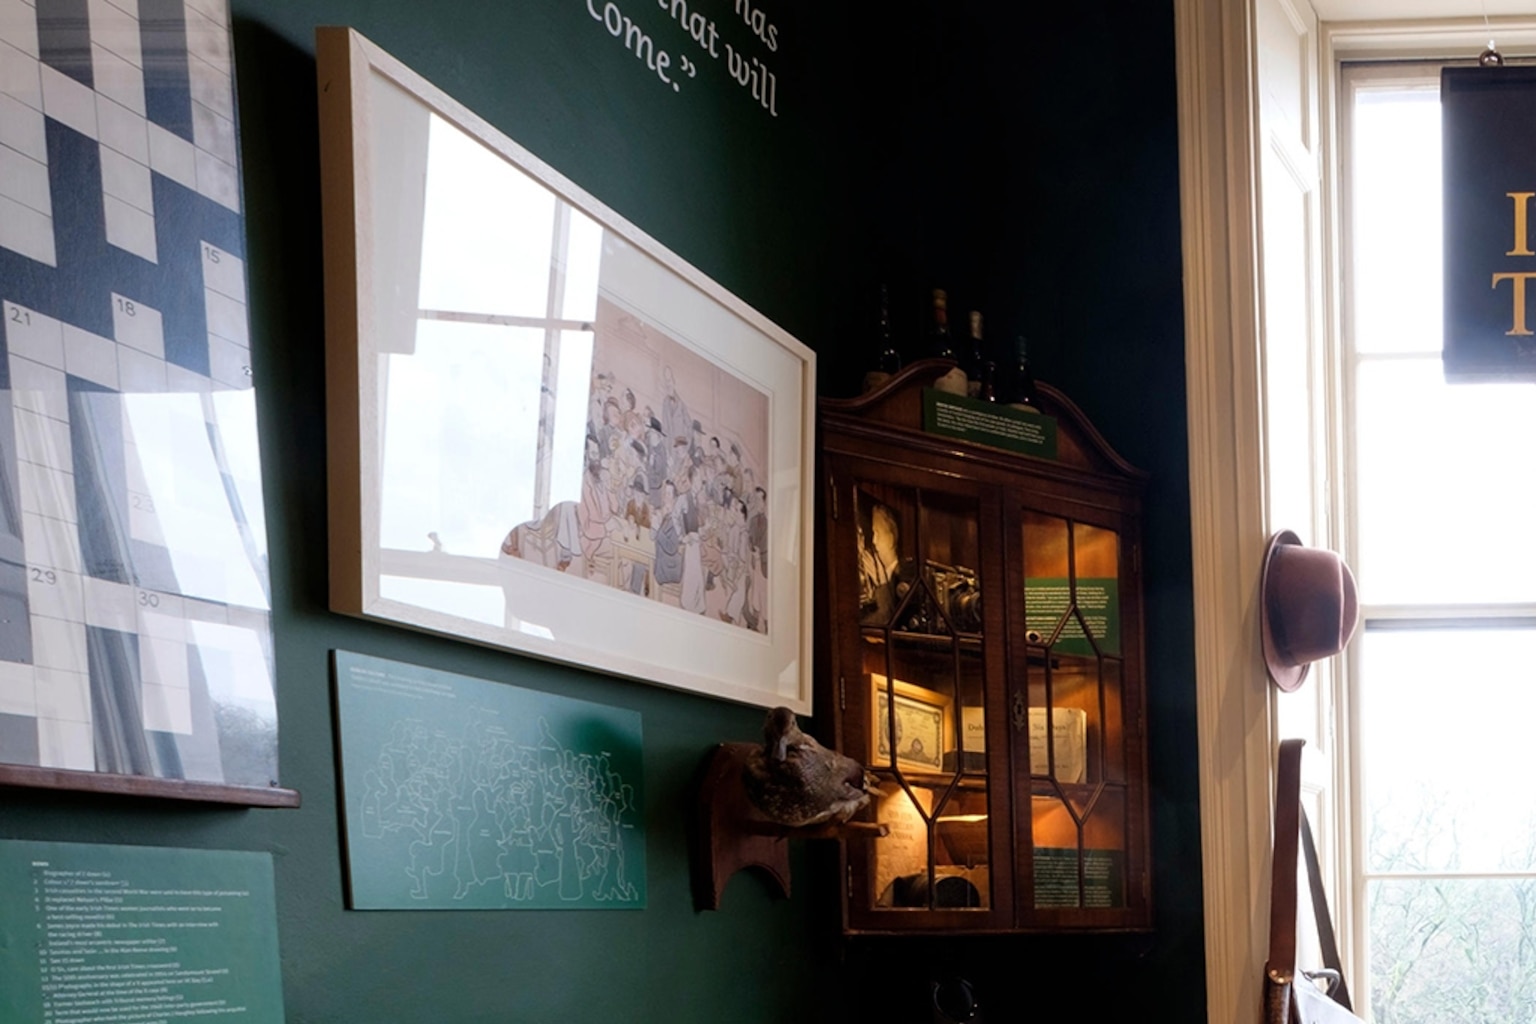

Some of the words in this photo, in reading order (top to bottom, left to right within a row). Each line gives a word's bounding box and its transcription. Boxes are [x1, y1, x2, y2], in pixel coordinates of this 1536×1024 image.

[725, 43, 778, 117] will
[204, 246, 221, 264] 15
[10, 306, 31, 326] 21
[117, 298, 136, 317] 18
[31, 568, 57, 586] 29
[138, 591, 160, 609] 30
